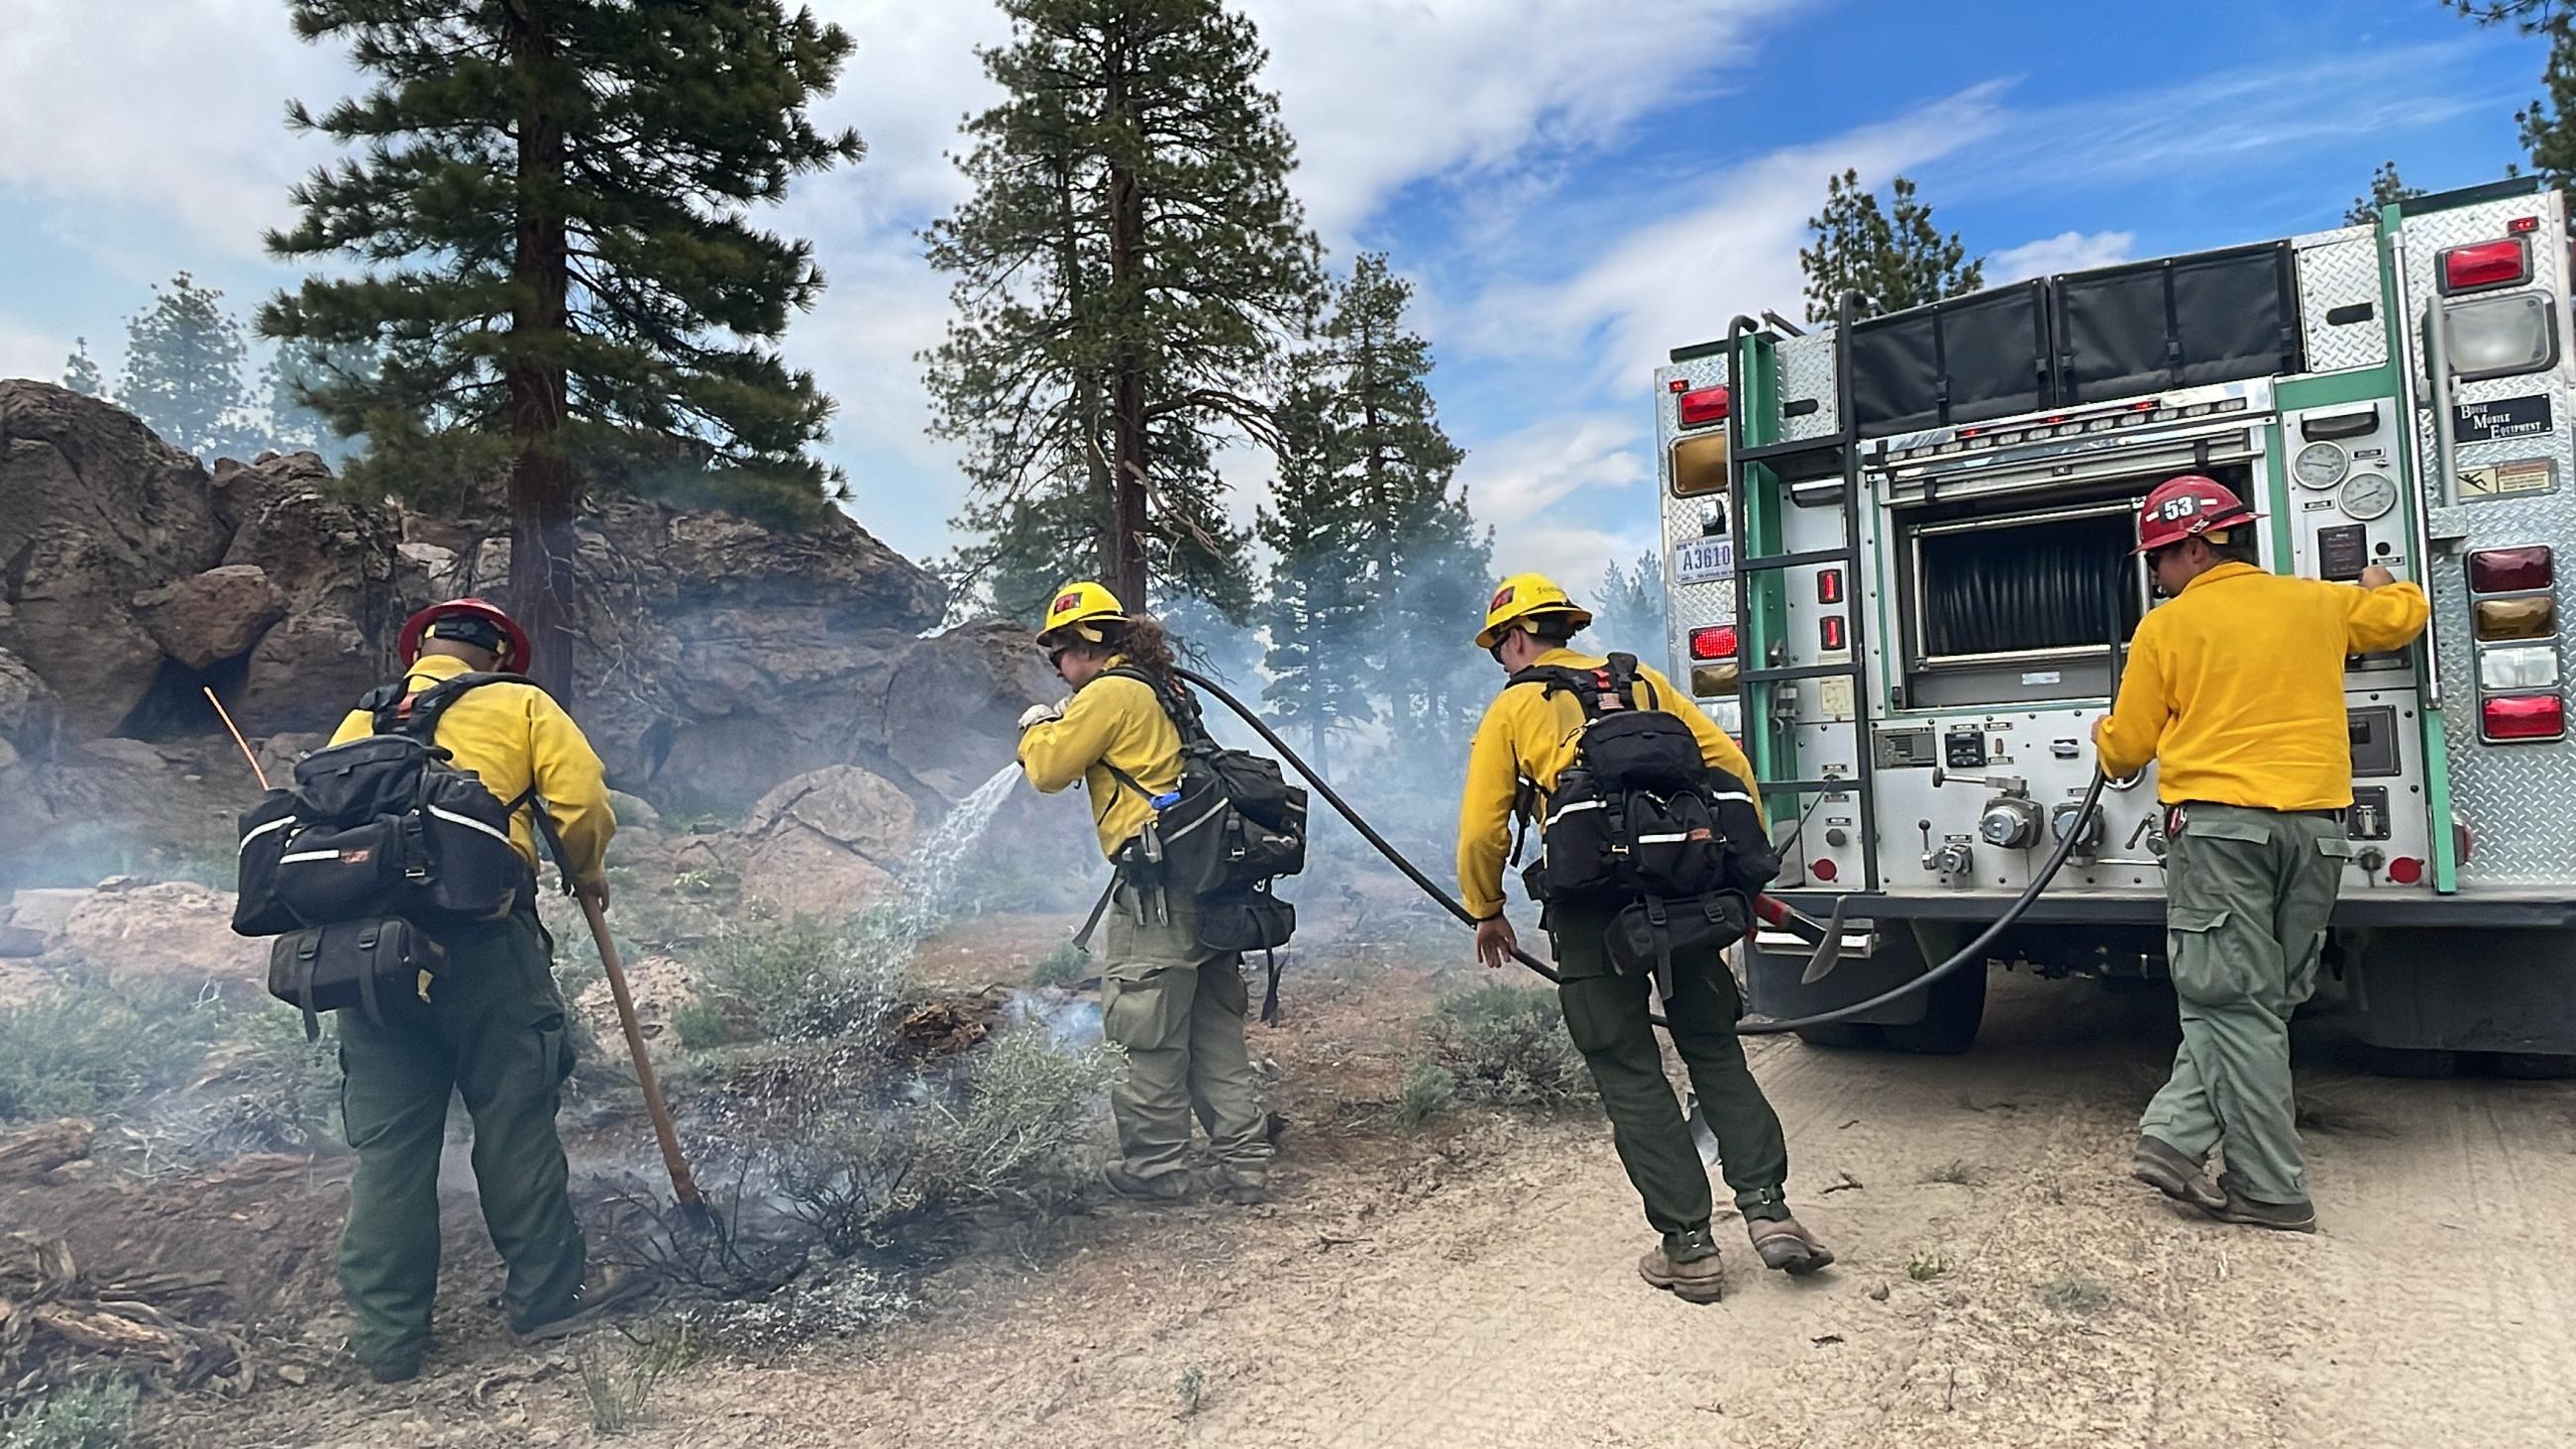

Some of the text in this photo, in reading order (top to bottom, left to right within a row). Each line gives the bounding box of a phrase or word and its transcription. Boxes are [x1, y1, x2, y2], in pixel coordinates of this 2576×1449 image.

[2473, 413, 2511, 429] MOBILE
[2490, 421, 2541, 439] EQUIPMENT
[2164, 496, 2194, 520] 53
